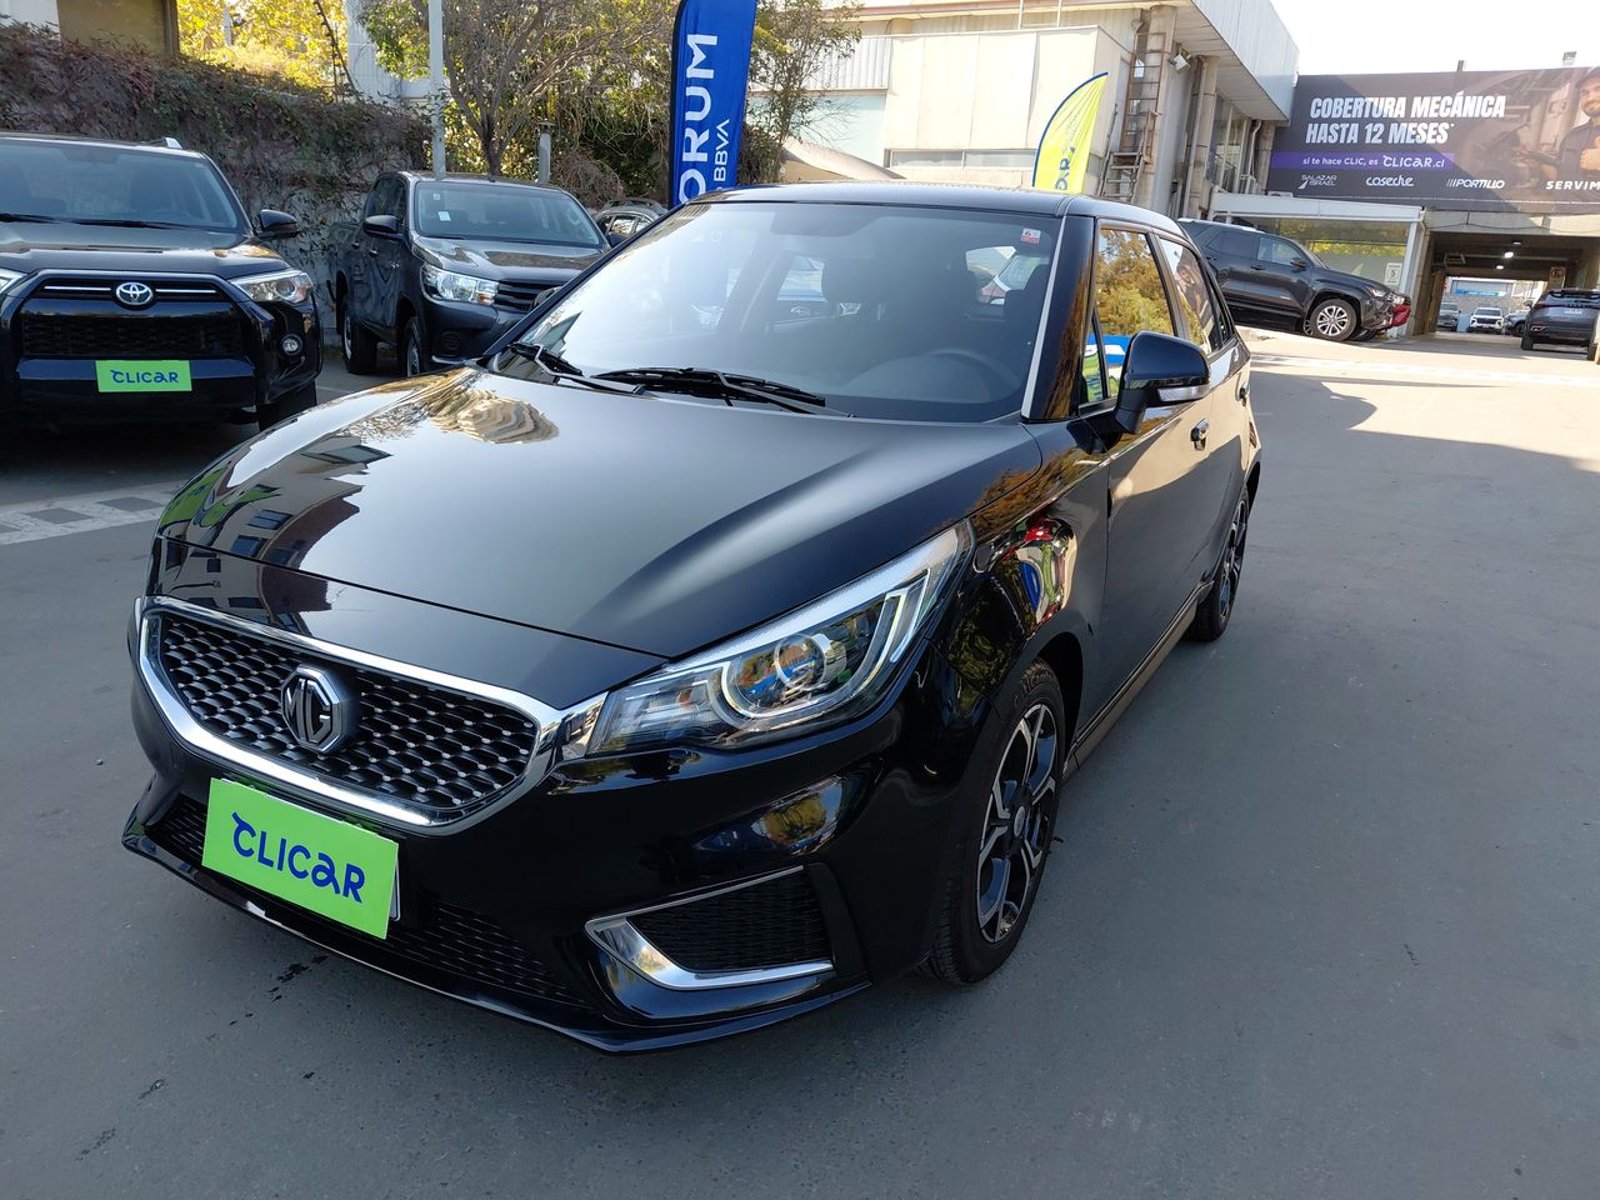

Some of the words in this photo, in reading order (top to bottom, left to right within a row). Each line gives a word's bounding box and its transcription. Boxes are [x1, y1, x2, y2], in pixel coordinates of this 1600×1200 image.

[1309, 97, 1406, 119] COBERTURA
[1411, 90, 1506, 118] MECÁNICA
[1305, 123, 1359, 144] HASTA
[1364, 123, 1384, 144] 12
[1388, 122, 1450, 144] MESES
[713, 119, 730, 182] BBVA
[1322, 158, 1342, 166] hace
[1344, 158, 1367, 167] CLIC,
[1455, 178, 1505, 190] PORTILLO
[284, 677, 332, 744] MG
